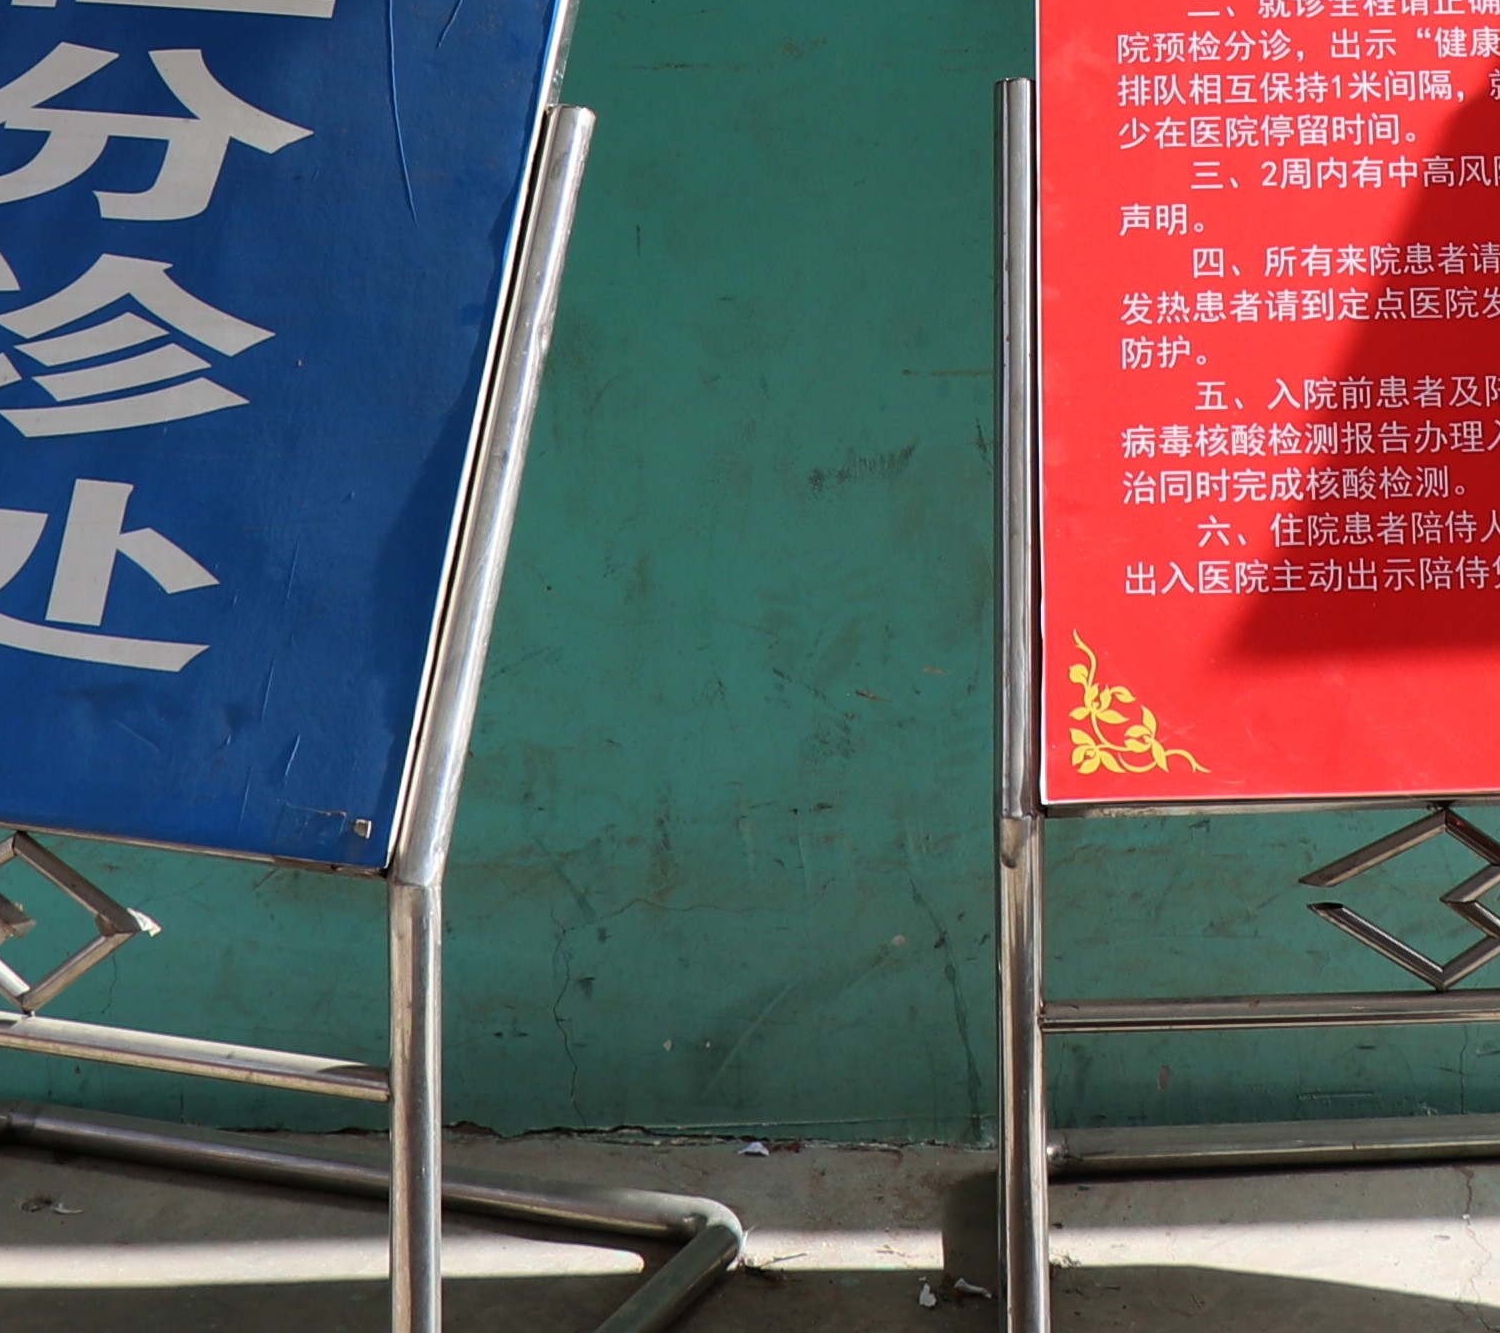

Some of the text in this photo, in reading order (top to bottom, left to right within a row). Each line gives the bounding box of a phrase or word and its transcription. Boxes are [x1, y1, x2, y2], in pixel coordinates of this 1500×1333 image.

[1119, 114, 1415, 147] 少在医院停留时间。
[1120, 203, 1203, 235] 声明。
[1122, 335, 1206, 368] 防护。
[1123, 465, 1464, 503] 治同时完成核酸检测。
